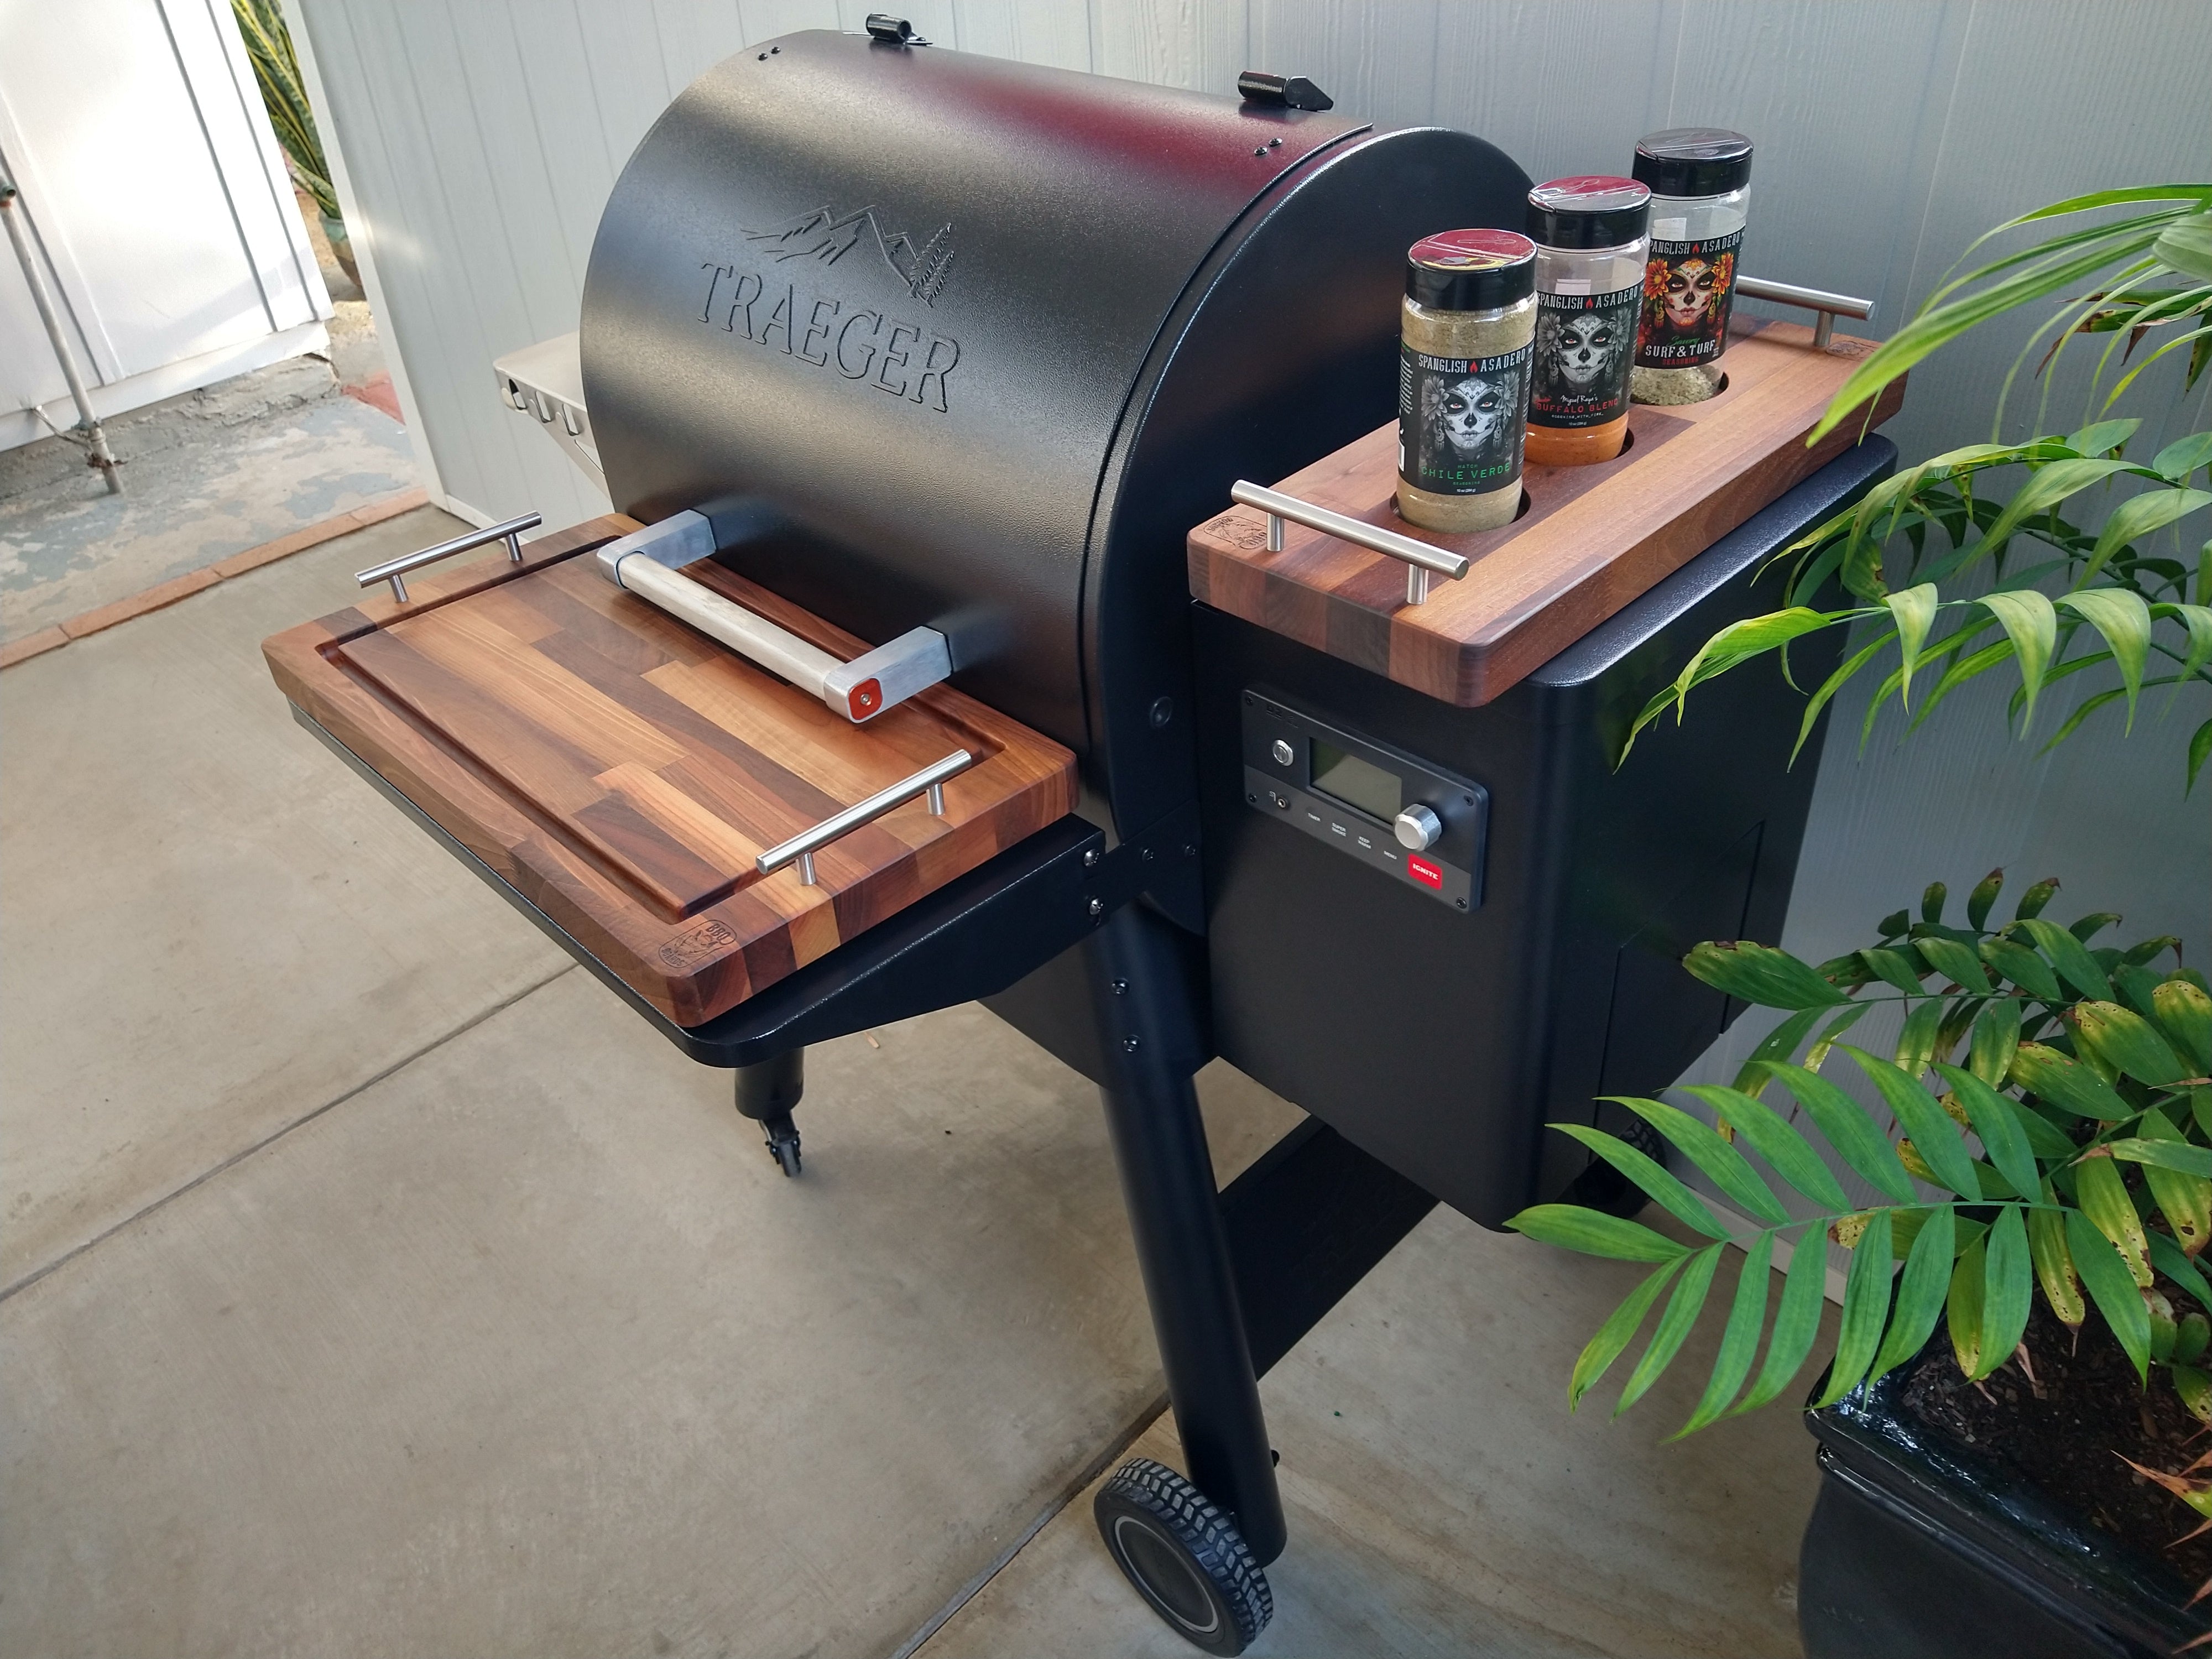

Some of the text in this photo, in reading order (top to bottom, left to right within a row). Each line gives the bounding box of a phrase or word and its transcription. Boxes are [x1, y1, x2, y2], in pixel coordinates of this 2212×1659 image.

[1650, 240, 1691, 255] PANGLISH
[1702, 231, 1740, 254] ASADERO
[1537, 292, 1583, 310] SPANGLISH
[1595, 285, 1638, 309] ASADERO
[698, 263, 961, 414] TRAEGER
[1645, 345, 1676, 358] SURF
[1677, 346, 1686, 357] &
[1689, 339, 1715, 356] TURF
[1418, 353, 1468, 373] SPANGLISH
[1480, 348, 1526, 373] ASADERO
[1536, 398, 1619, 413] BUFFALO BLEND
[1421, 462, 1511, 480] CHILE VERDE
[1308, 812, 1321, 822] TIMER
[1332, 822, 1346, 832] SUPER
[1332, 827, 1347, 837] SMOKE
[1358, 839, 1371, 849] WARM
[1359, 836, 1370, 844] KEEP
[1384, 850, 1397, 860] MENU
[1412, 863, 1438, 880] IGNITE
[662, 948, 685, 966] BOARDS
